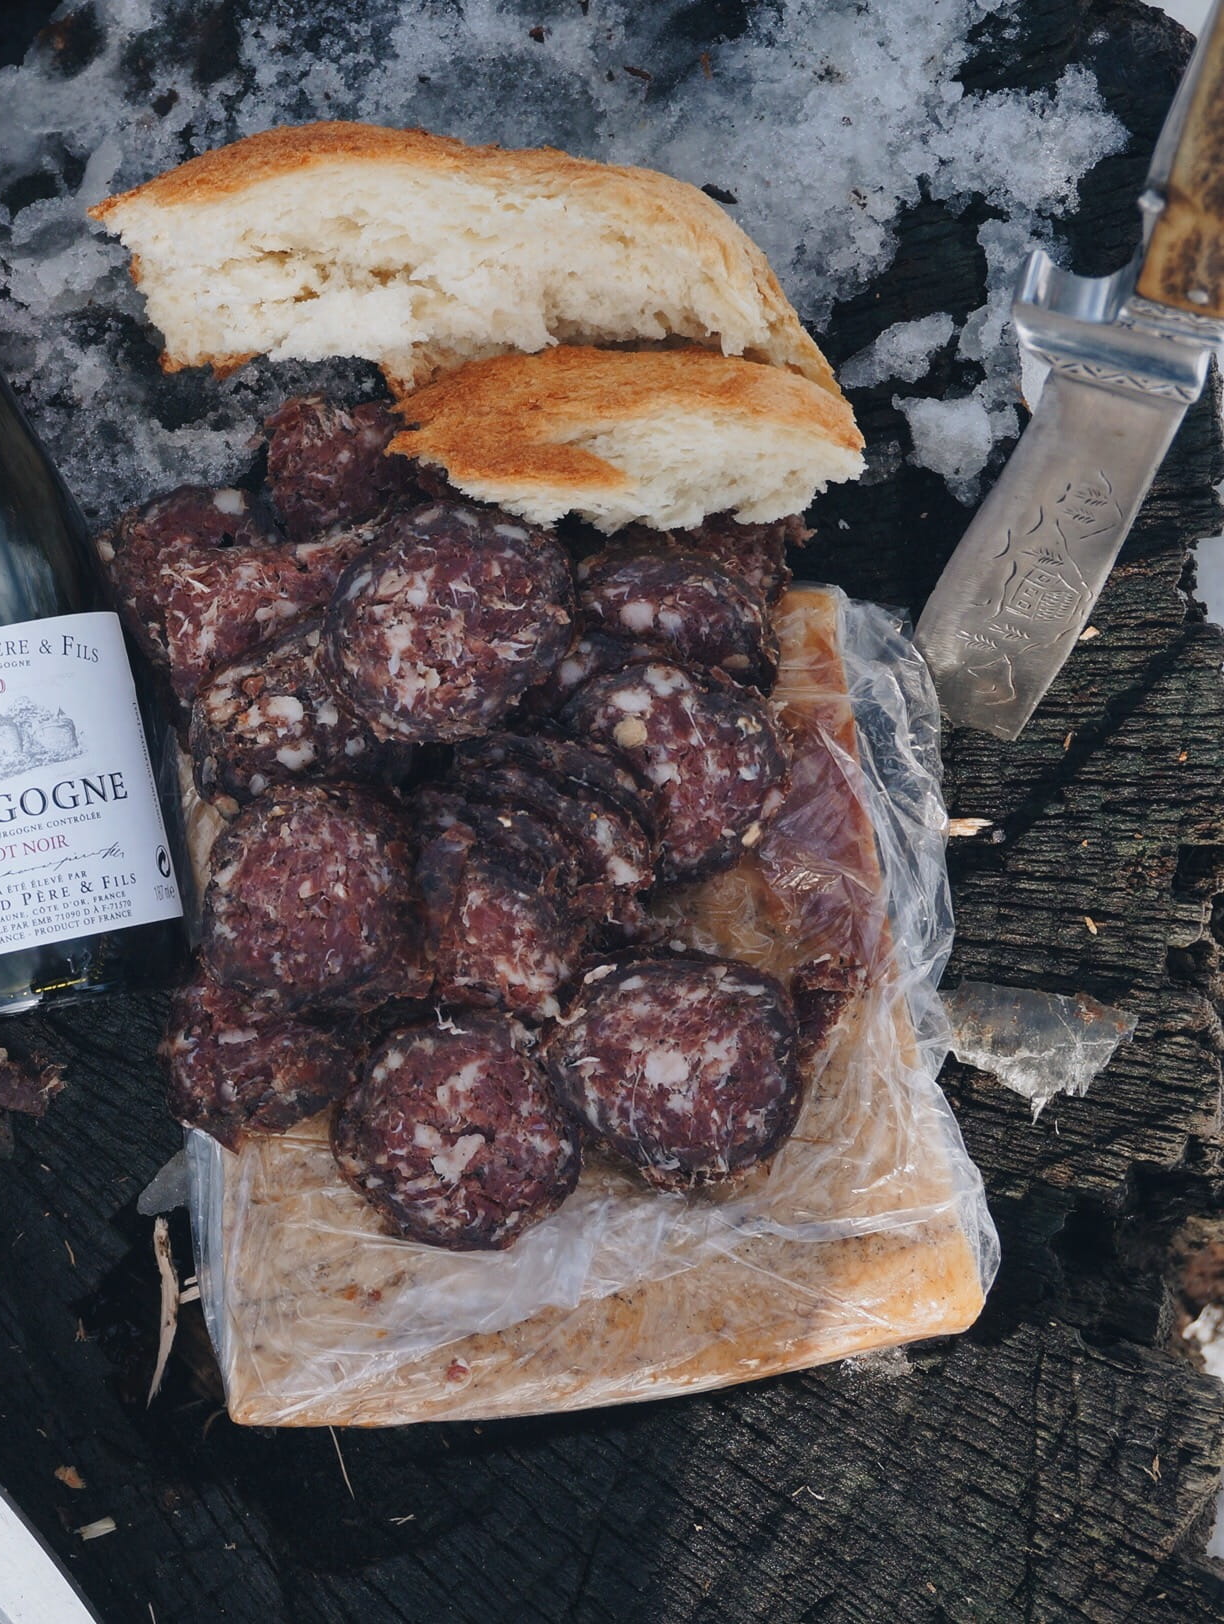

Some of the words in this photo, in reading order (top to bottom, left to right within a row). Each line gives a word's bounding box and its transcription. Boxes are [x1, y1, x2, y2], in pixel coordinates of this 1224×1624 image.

[39, 639, 53, 655] &
[62, 634, 99, 663] FILS
[22, 834, 70, 856] NOIR
[68, 870, 88, 881] PAR
[21, 887, 71, 906] PÈRE
[80, 880, 93, 894] &
[101, 873, 137, 889] FILS
[93, 890, 126, 903] FRANCE
[10, 921, 29, 931] PAR
[32, 915, 52, 927] EMB
[55, 911, 81, 922] 71090
[83, 907, 91, 916] D
[34, 919, 80, 937] PRODUCT
[83, 916, 96, 926] OF
[98, 909, 132, 923] FRANCE
